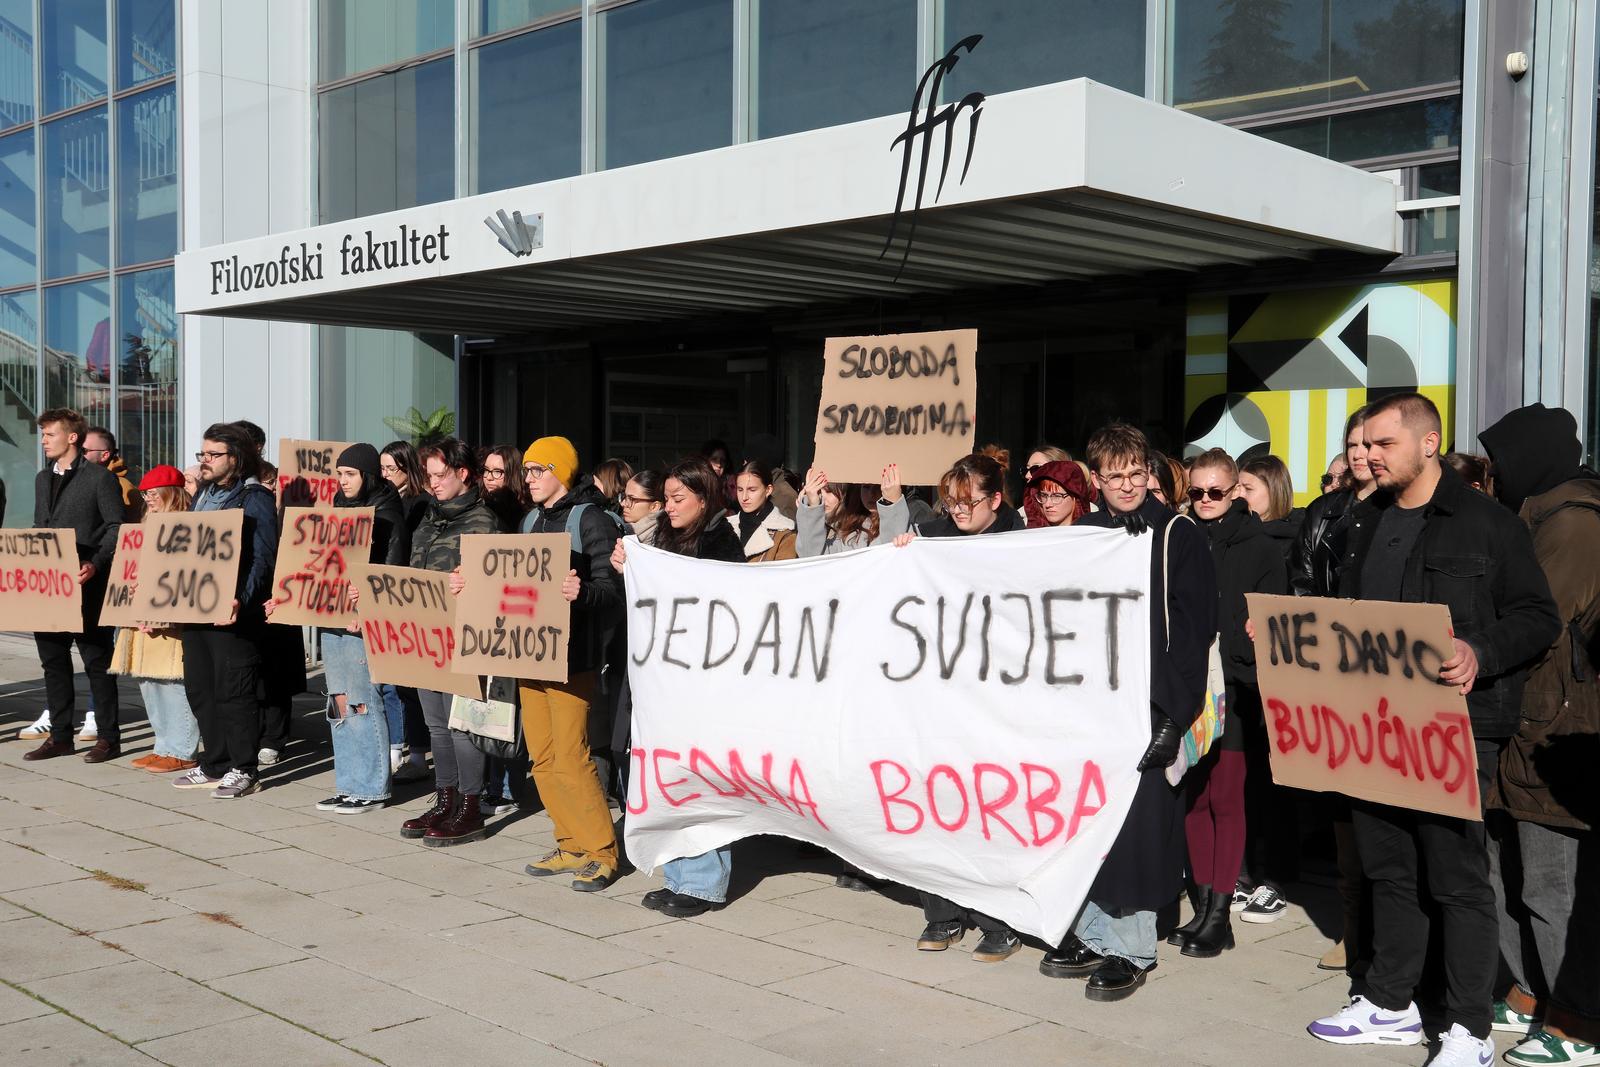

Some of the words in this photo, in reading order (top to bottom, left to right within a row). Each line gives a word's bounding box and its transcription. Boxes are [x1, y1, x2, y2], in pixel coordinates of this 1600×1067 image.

[210, 242, 324, 295] Filozofski
[340, 224, 450, 275] fakultet
[839, 343, 960, 386] SLOBODA
[823, 401, 971, 436] STUDENTIMA
[296, 448, 333, 475] NIJE
[0, 533, 62, 559] NJETI
[197, 523, 234, 560] VAS
[293, 513, 372, 547] STUDENTI
[304, 547, 347, 576] ZA
[482, 548, 552, 581] OTPOR
[150, 569, 220, 614] SMO
[275, 573, 358, 615] STUDEN
[367, 573, 447, 612] PROTIV
[461, 616, 562, 660] DUŽNOST
[632, 598, 839, 682] JEDAN
[881, 589, 1144, 690] SVIJET
[1268, 612, 1320, 671] NE
[1330, 621, 1460, 686] DAMO
[869, 759, 1106, 847] BORBA
